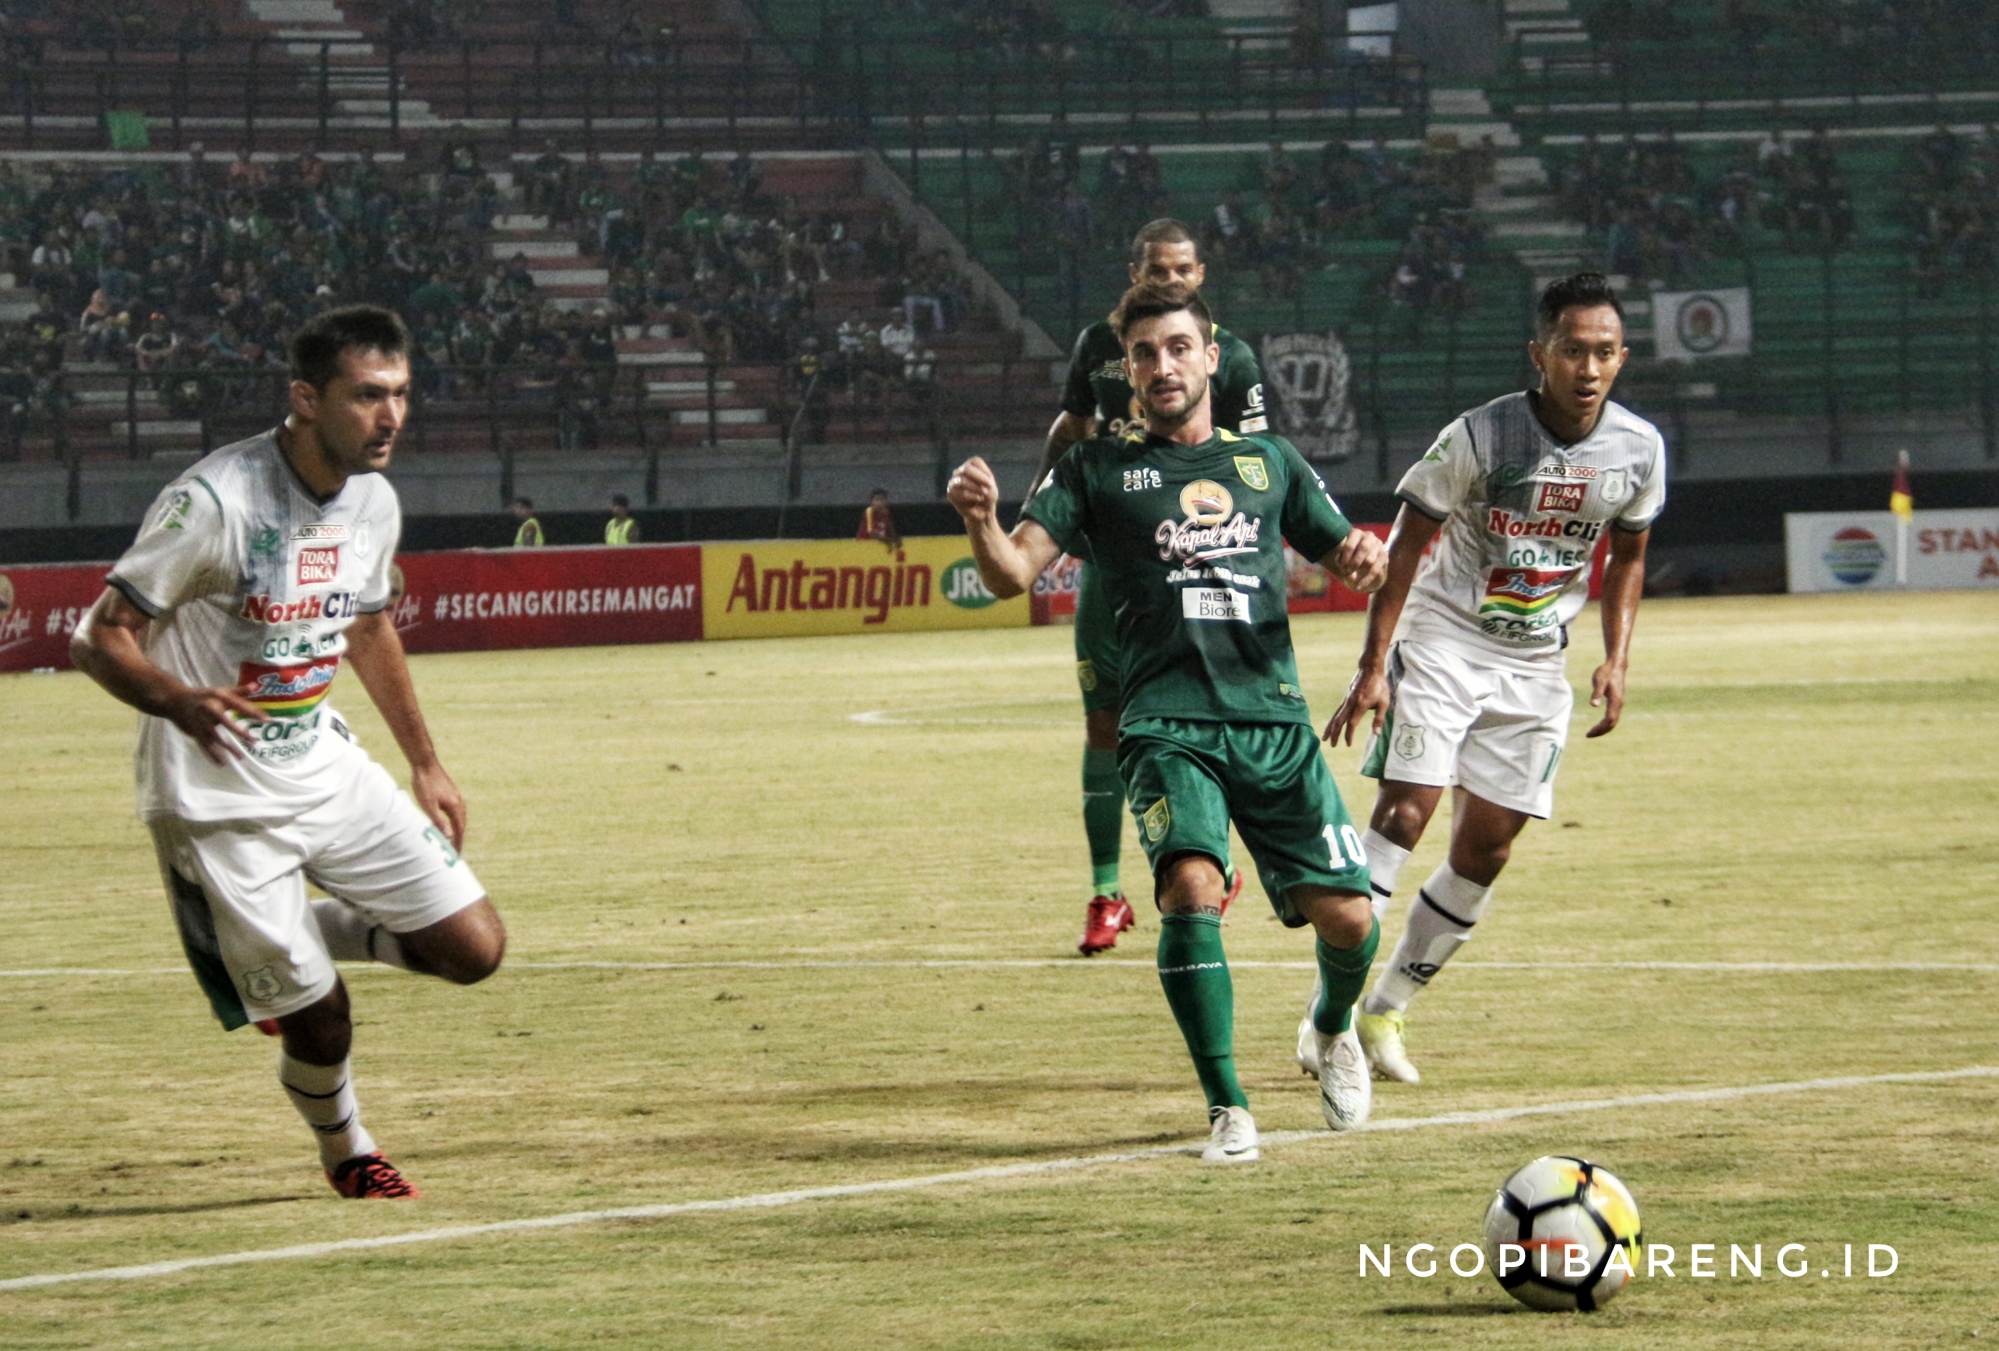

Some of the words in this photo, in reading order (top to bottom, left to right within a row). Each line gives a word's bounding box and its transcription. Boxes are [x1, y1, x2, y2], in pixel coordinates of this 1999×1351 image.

[1123, 467, 1160, 480] safe
[1537, 466, 1567, 476] AUTO
[1568, 467, 1597, 478] 2000
[1123, 478, 1162, 492] care
[1546, 485, 1581, 500] TORA
[1543, 496, 1577, 510] BIKA
[319, 526, 347, 537] 2000
[1155, 519, 1221, 560] Kapal
[1219, 512, 1260, 548] Api
[300, 550, 336, 565] TORA
[1509, 549, 1536, 567] GO
[300, 565, 333, 580] BIKA
[726, 550, 932, 624] Antangin
[241, 591, 359, 625] NorthCli
[434, 584, 696, 620] #SECANGKIRSEMANGAT
[263, 637, 290, 658] GO
[1321, 823, 1368, 870] 10
